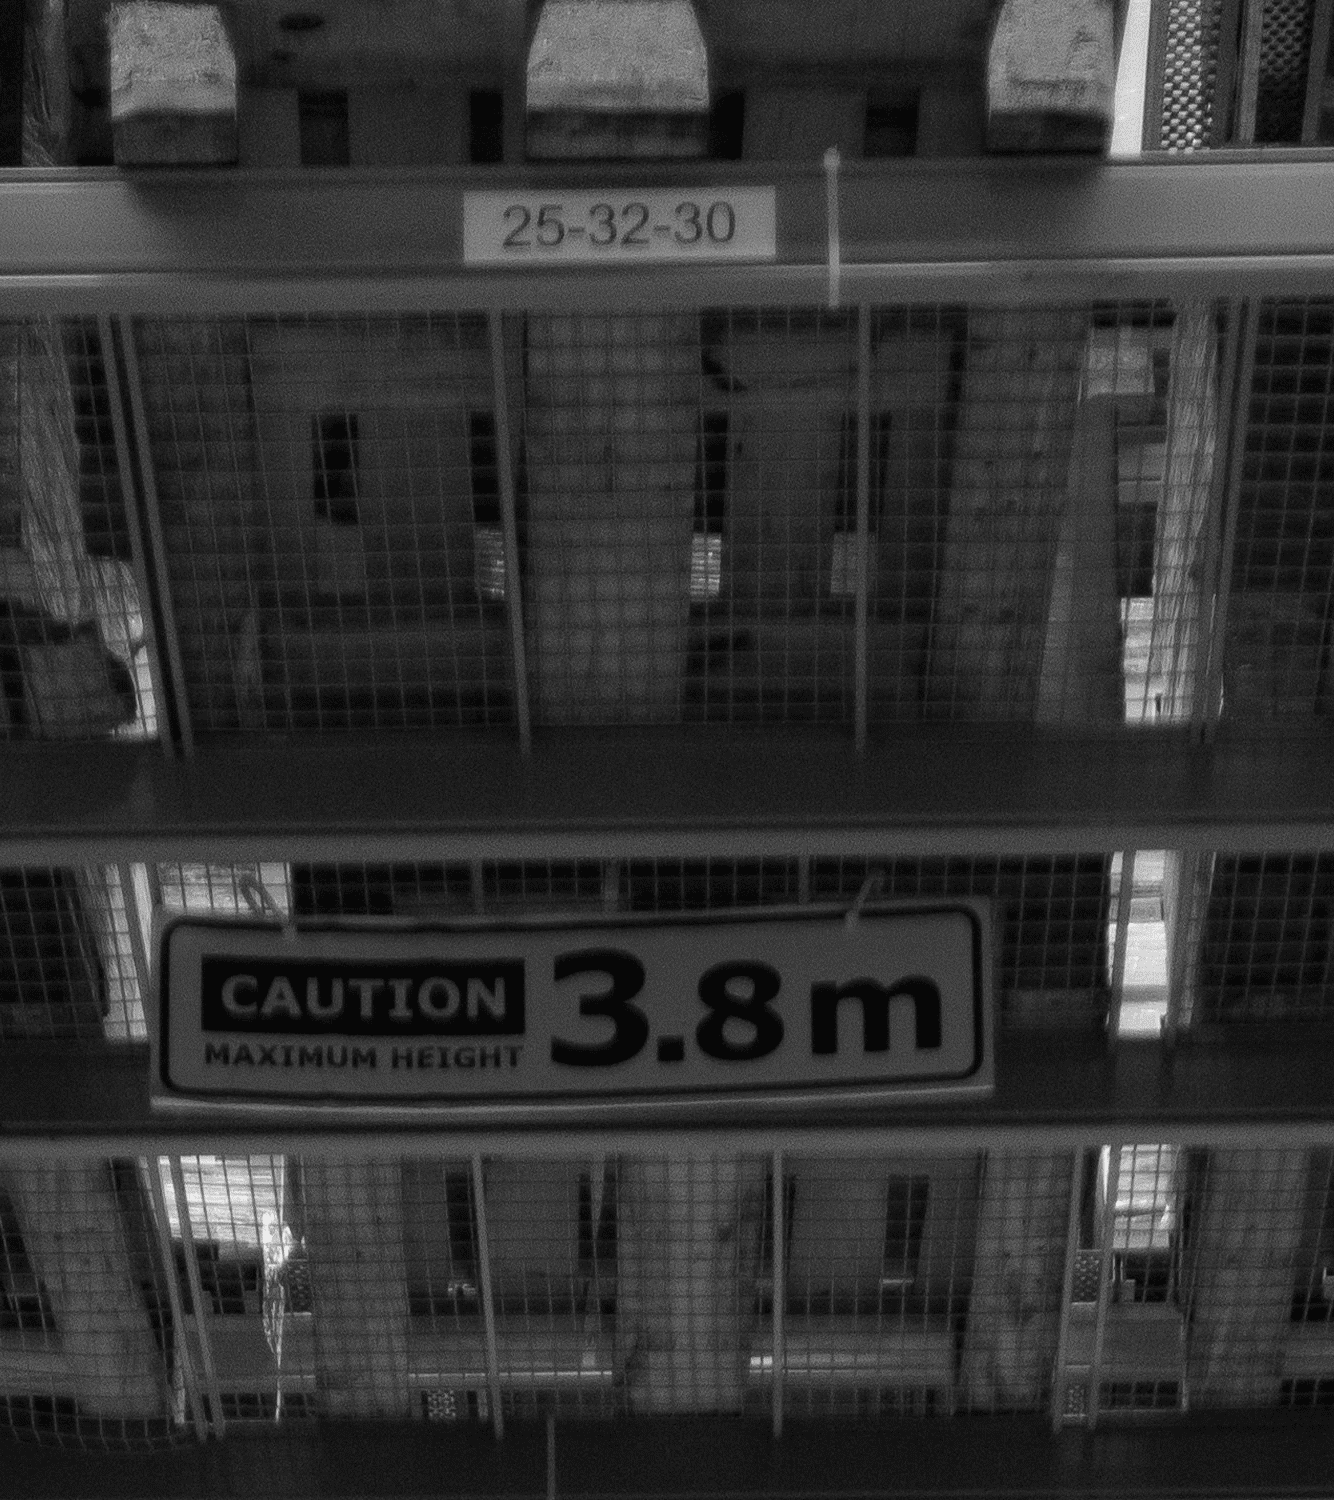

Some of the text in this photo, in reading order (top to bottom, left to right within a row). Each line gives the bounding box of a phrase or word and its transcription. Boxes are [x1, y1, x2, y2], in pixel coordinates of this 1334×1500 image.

[503, 201, 736, 248] 25-32-30
[221, 975, 507, 1018] CAUTION
[204, 1042, 525, 1070] MAXIMUM HEIGHT
